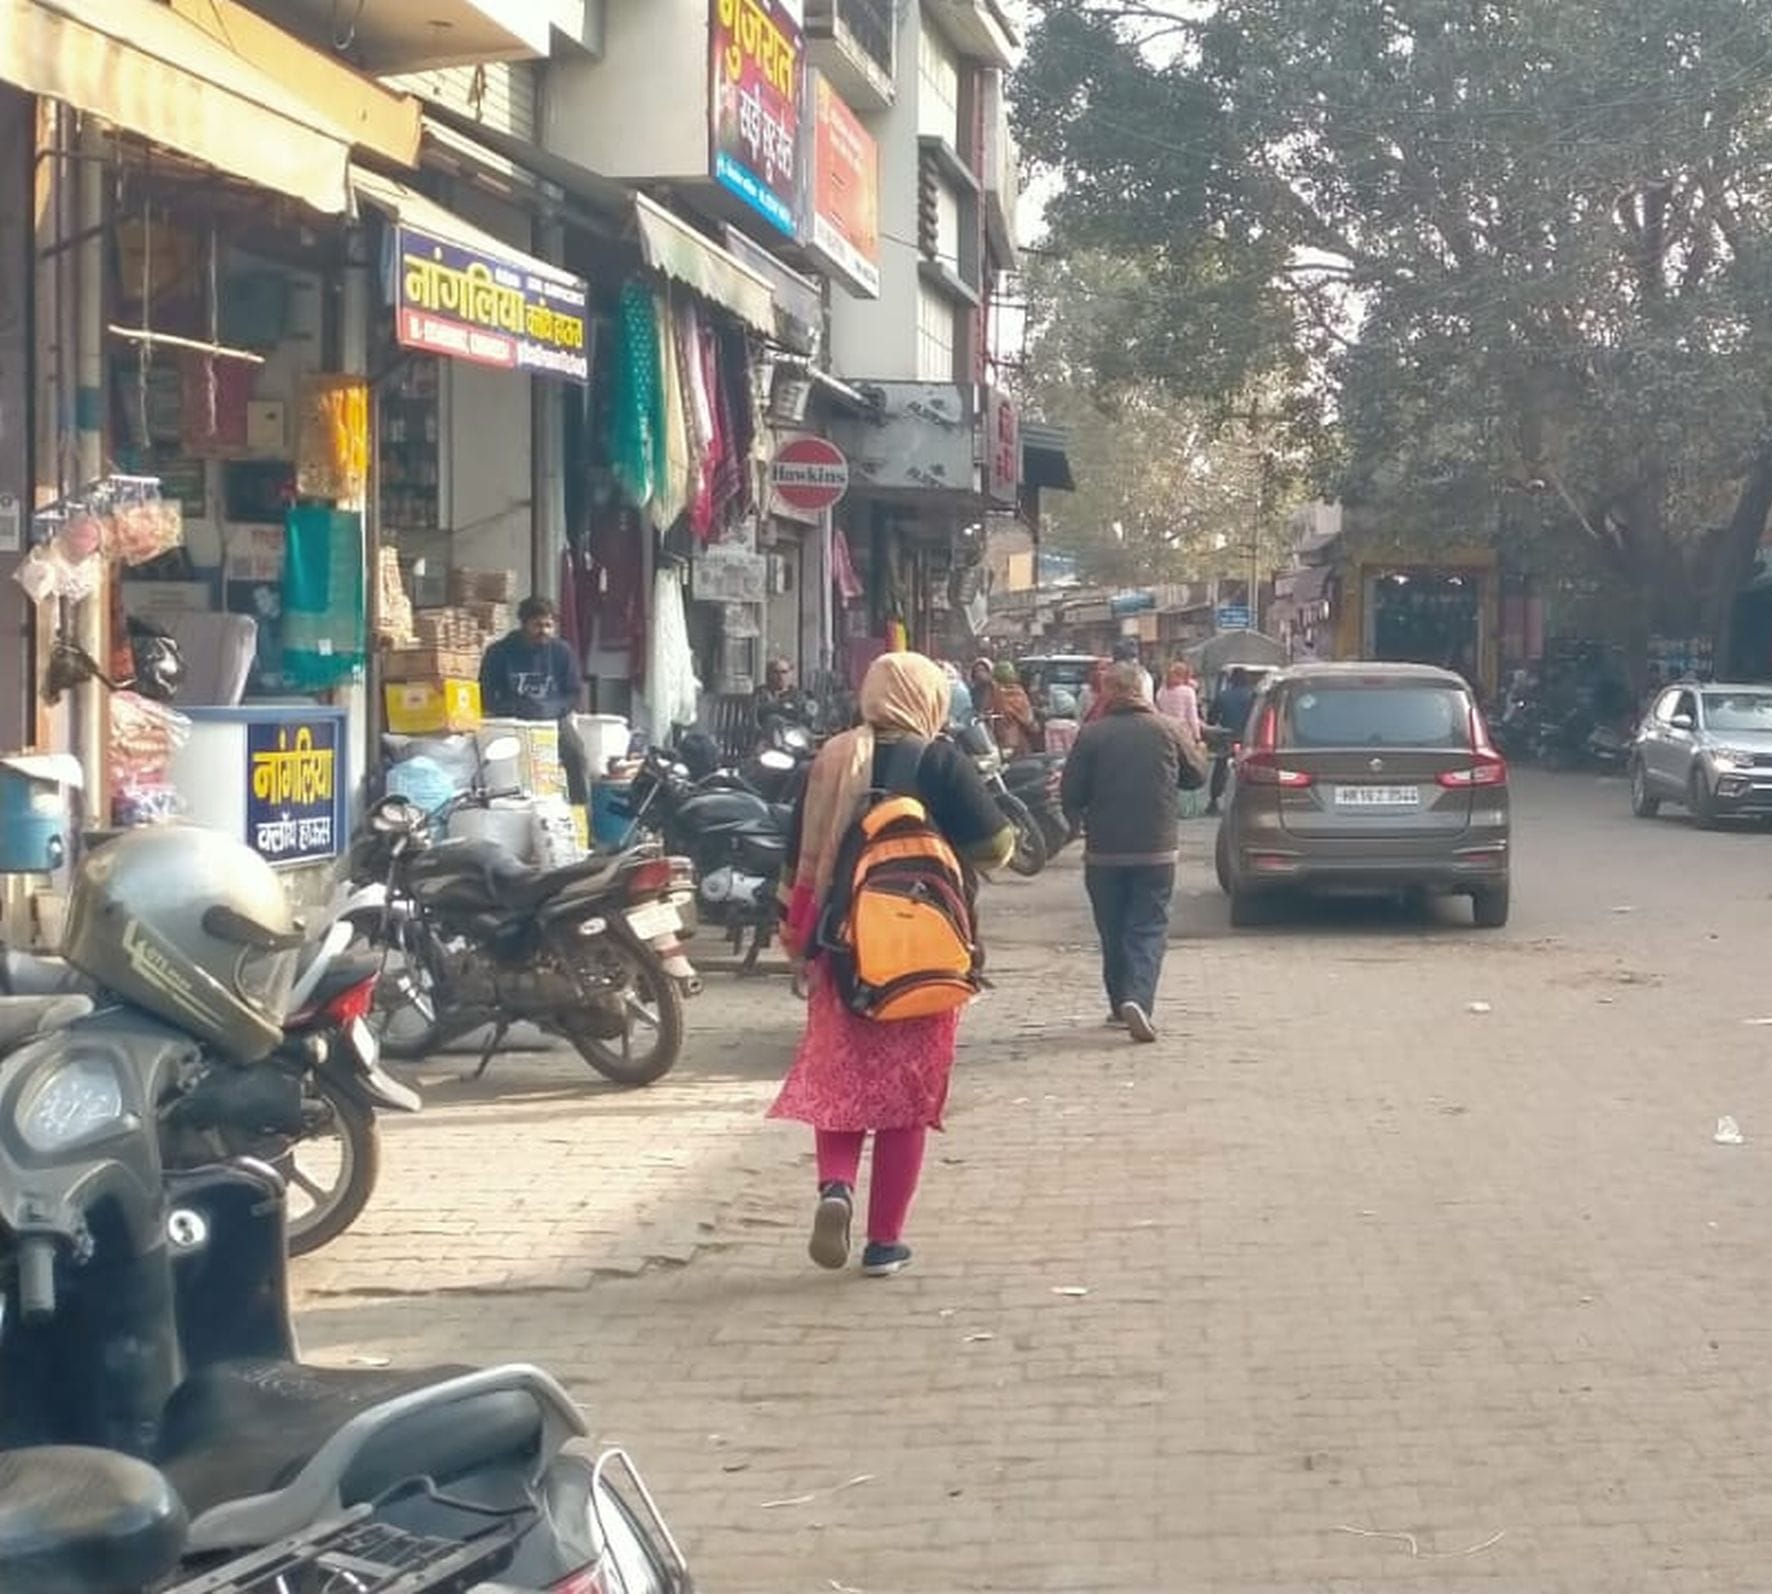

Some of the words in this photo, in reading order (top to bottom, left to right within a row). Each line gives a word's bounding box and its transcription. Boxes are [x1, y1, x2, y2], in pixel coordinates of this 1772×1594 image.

[403, 246, 526, 334] नांगलिया
[772, 464, 847, 484] Hawkins
[252, 726, 333, 805] नांगलिया
